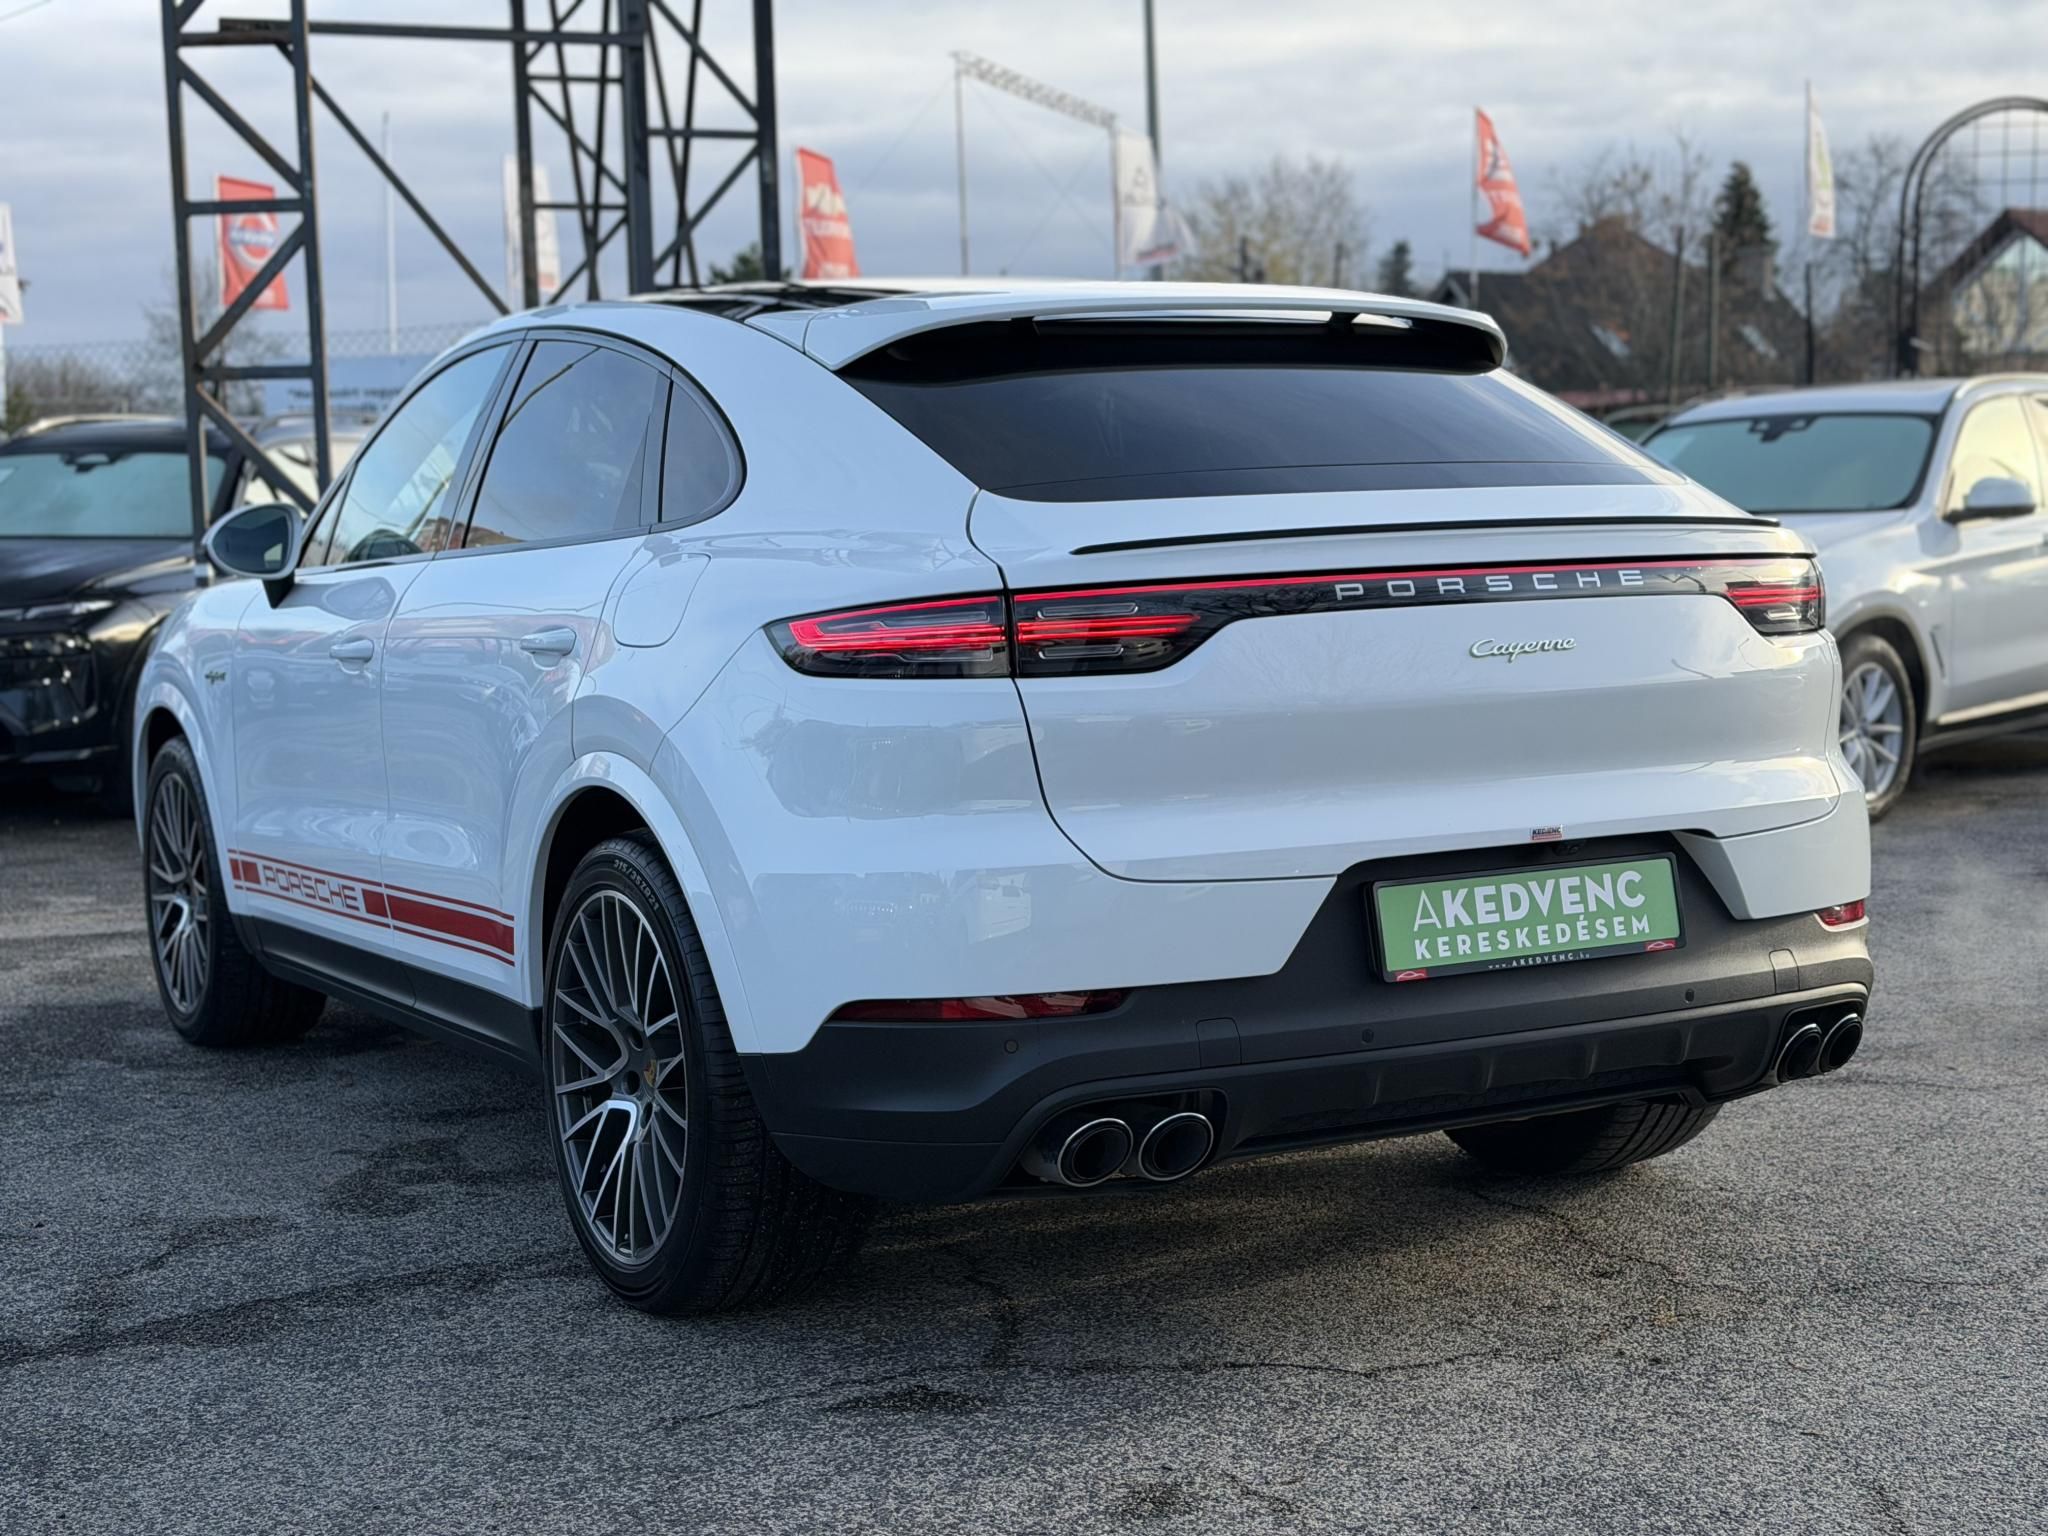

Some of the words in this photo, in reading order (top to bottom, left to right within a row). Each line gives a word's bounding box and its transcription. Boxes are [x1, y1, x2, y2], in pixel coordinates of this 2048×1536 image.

[1334, 569, 1645, 601] PORSCHE
[1468, 637, 1577, 664] Cayenne
[262, 865, 361, 912] PORSCHE
[1413, 870, 1646, 932] AKEDVENC
[1414, 914, 1651, 961] KERESKEDÉSEM
